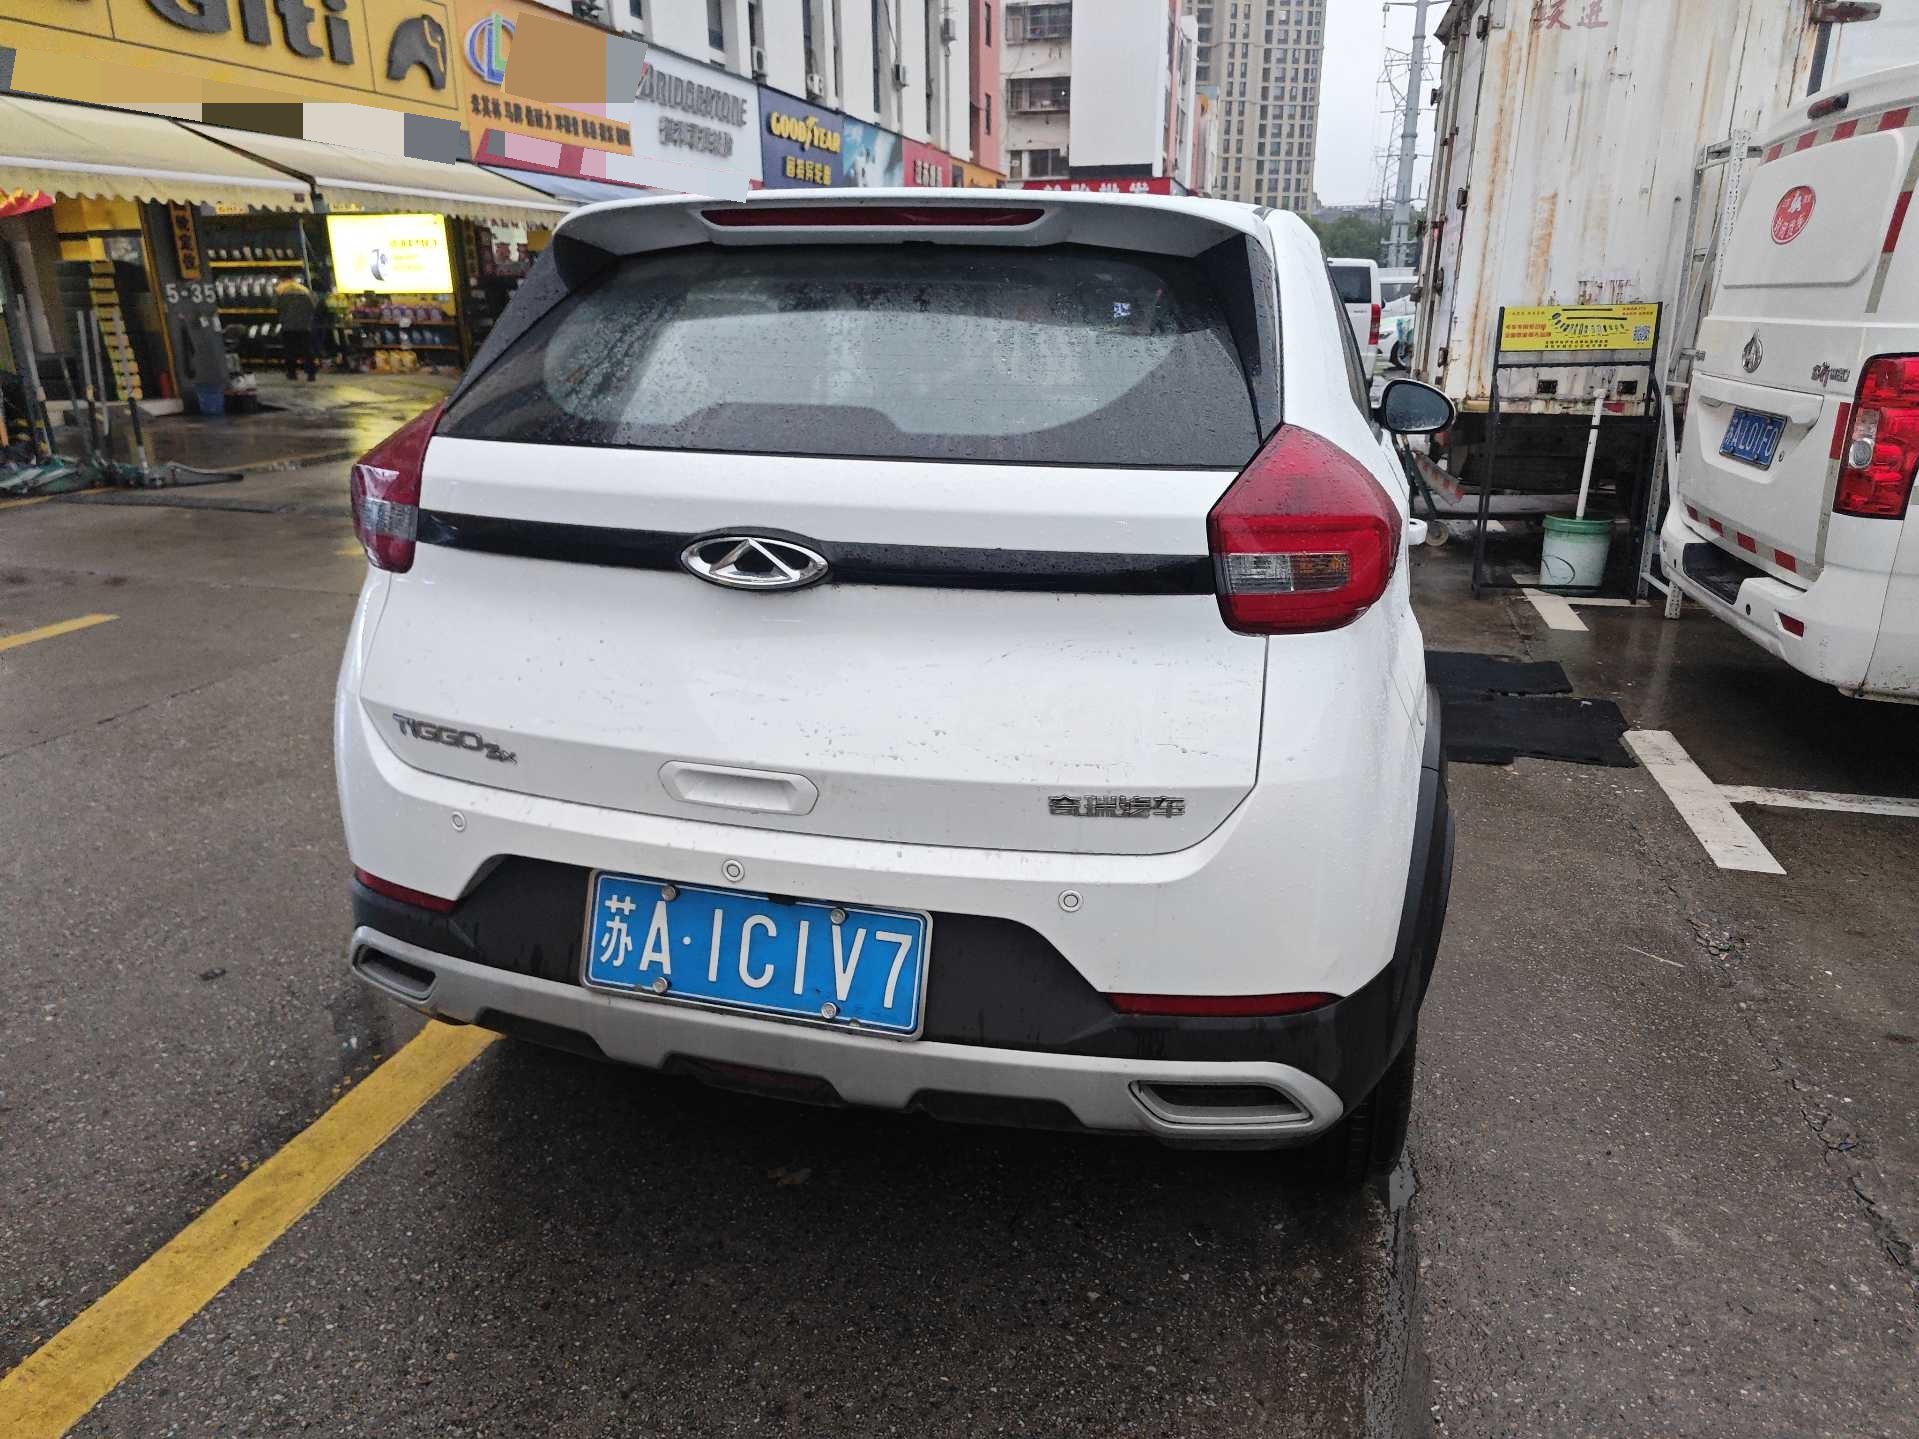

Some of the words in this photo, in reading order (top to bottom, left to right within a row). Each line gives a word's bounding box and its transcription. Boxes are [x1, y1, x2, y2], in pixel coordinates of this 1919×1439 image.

[771, 112, 841, 153] GOODYEAR
[1048, 794, 1185, 818] 奇瑞汽车
